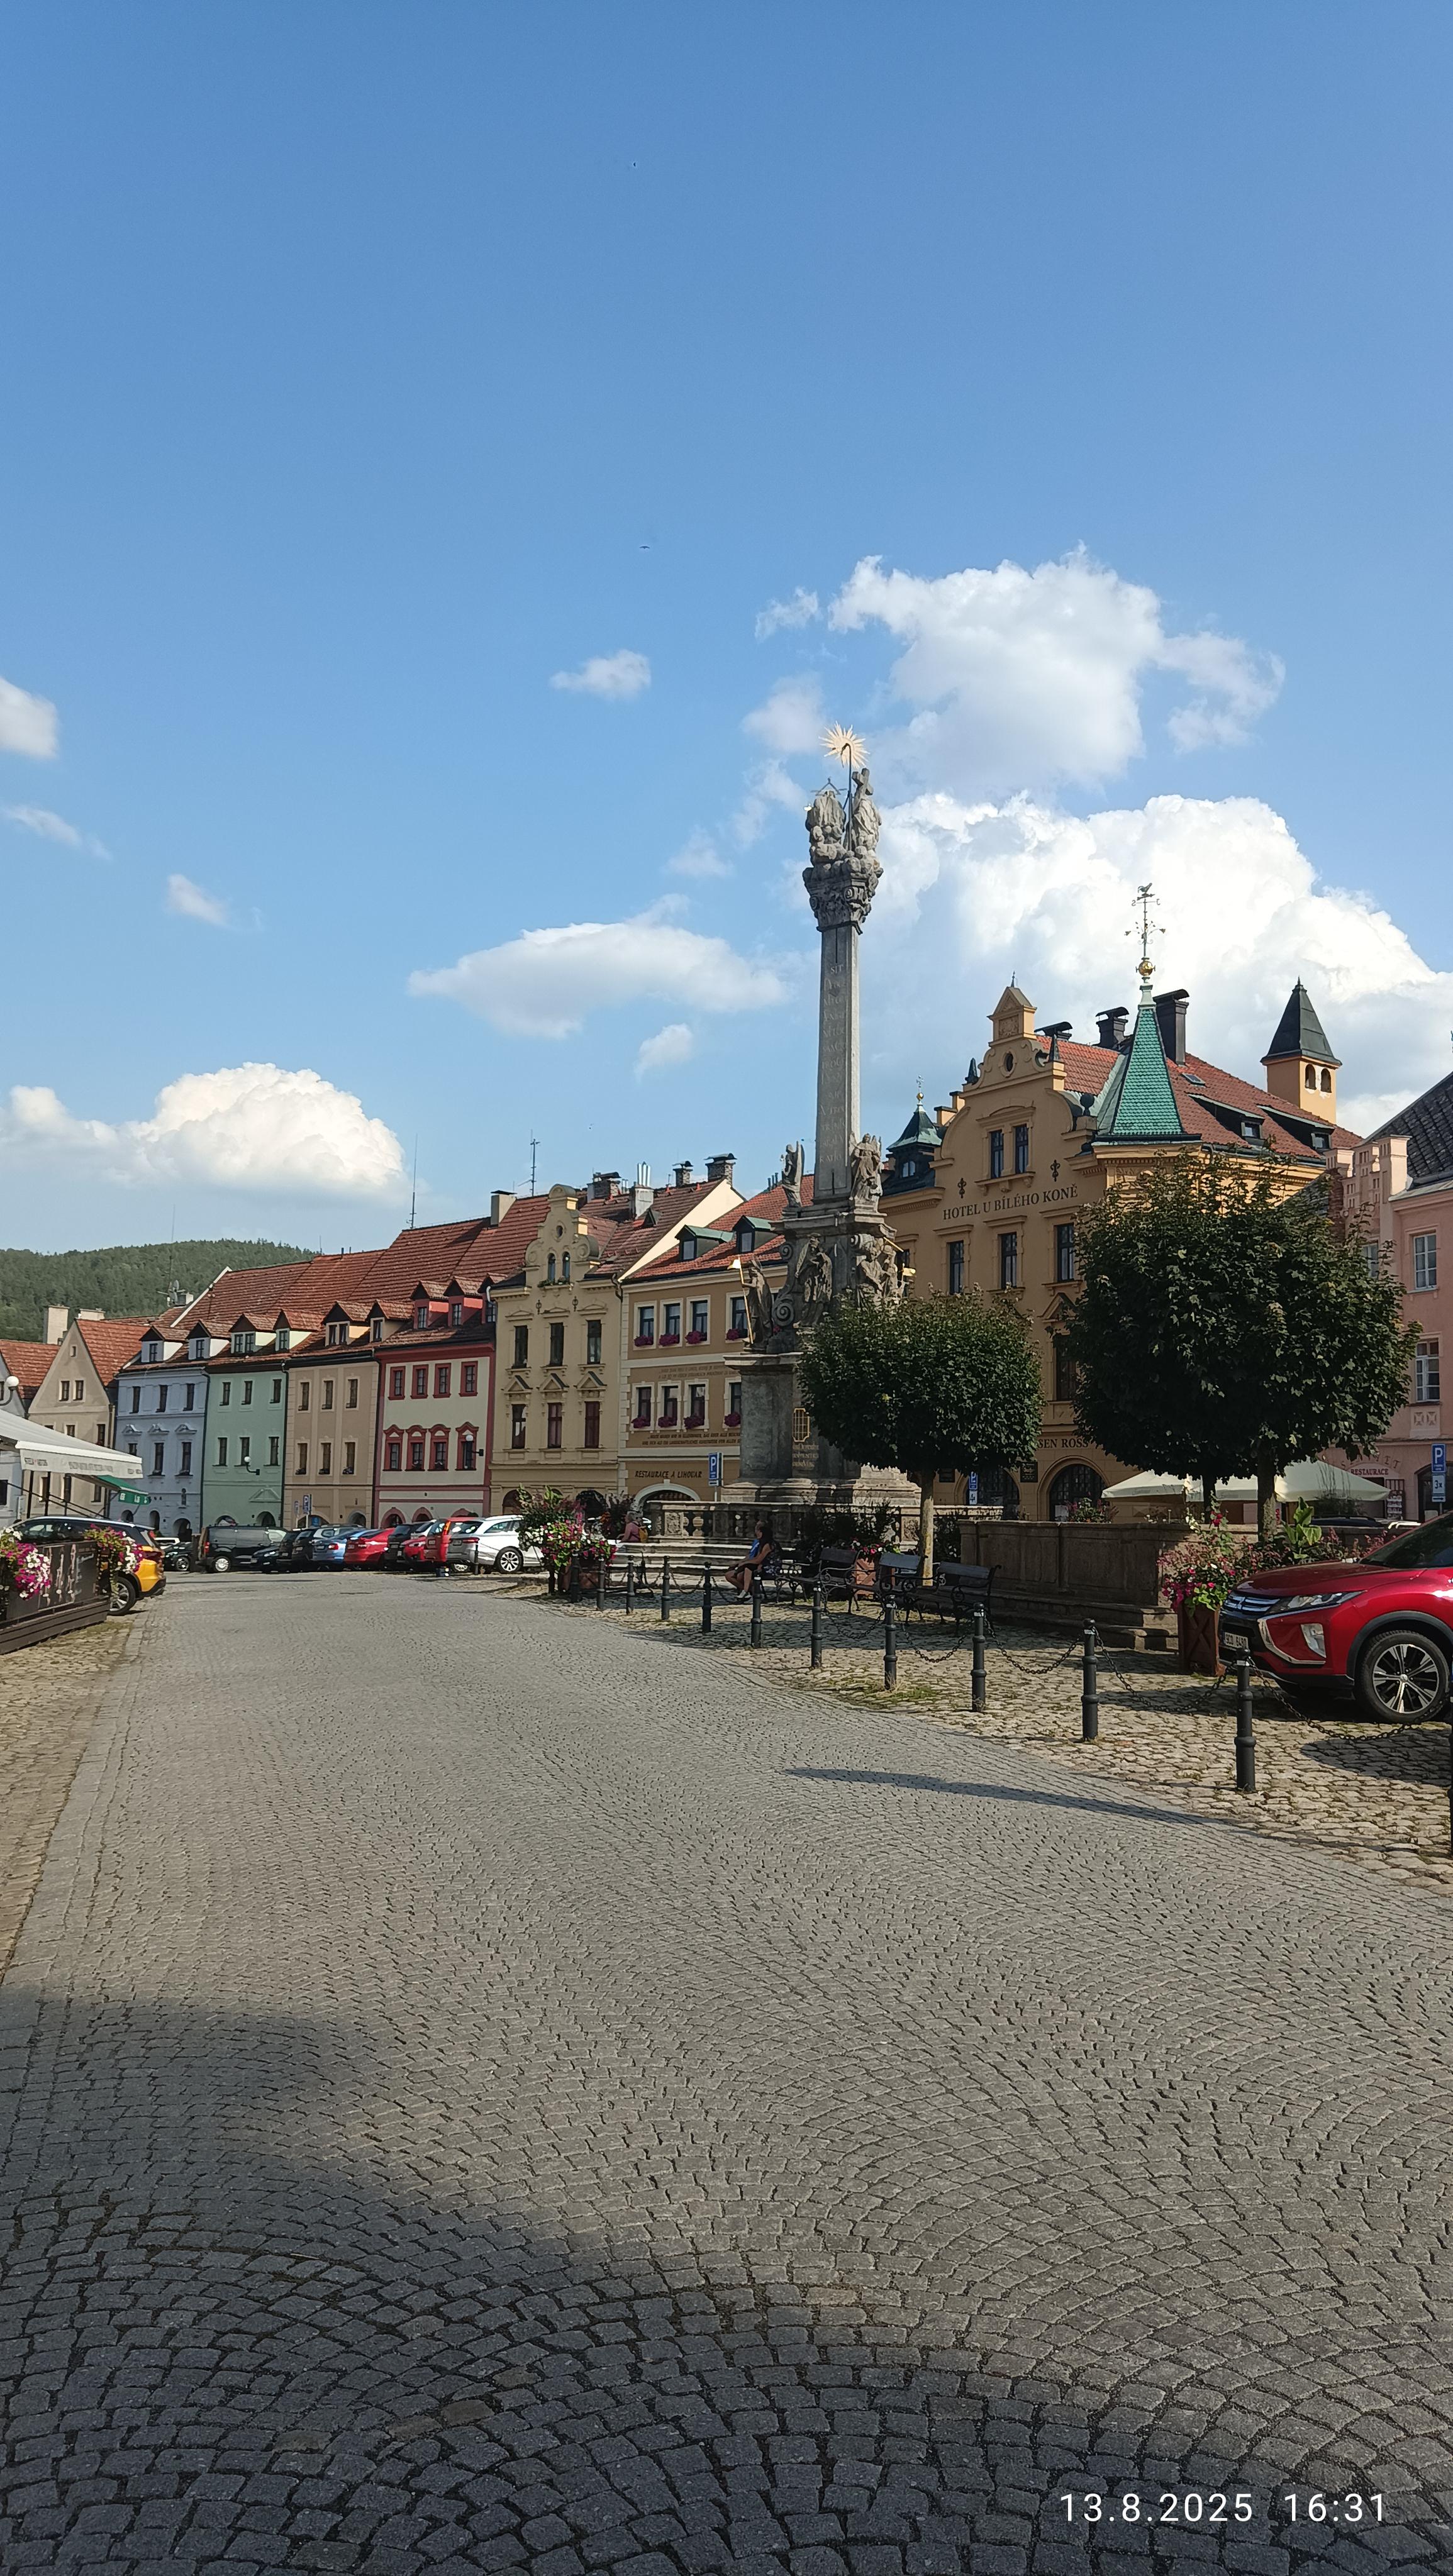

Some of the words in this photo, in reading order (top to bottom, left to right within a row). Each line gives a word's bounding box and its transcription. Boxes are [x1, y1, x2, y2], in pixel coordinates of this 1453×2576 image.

[943, 1204, 981, 1220] HOTEL
[983, 1202, 991, 1213] U
[994, 1192, 1039, 1211] BÍLÉHO
[1042, 1183, 1078, 1203] KONĚ
[1435, 1447, 1443, 1464] P
[710, 1457, 716, 1472] P
[1434, 1480, 1442, 1489] 3x
